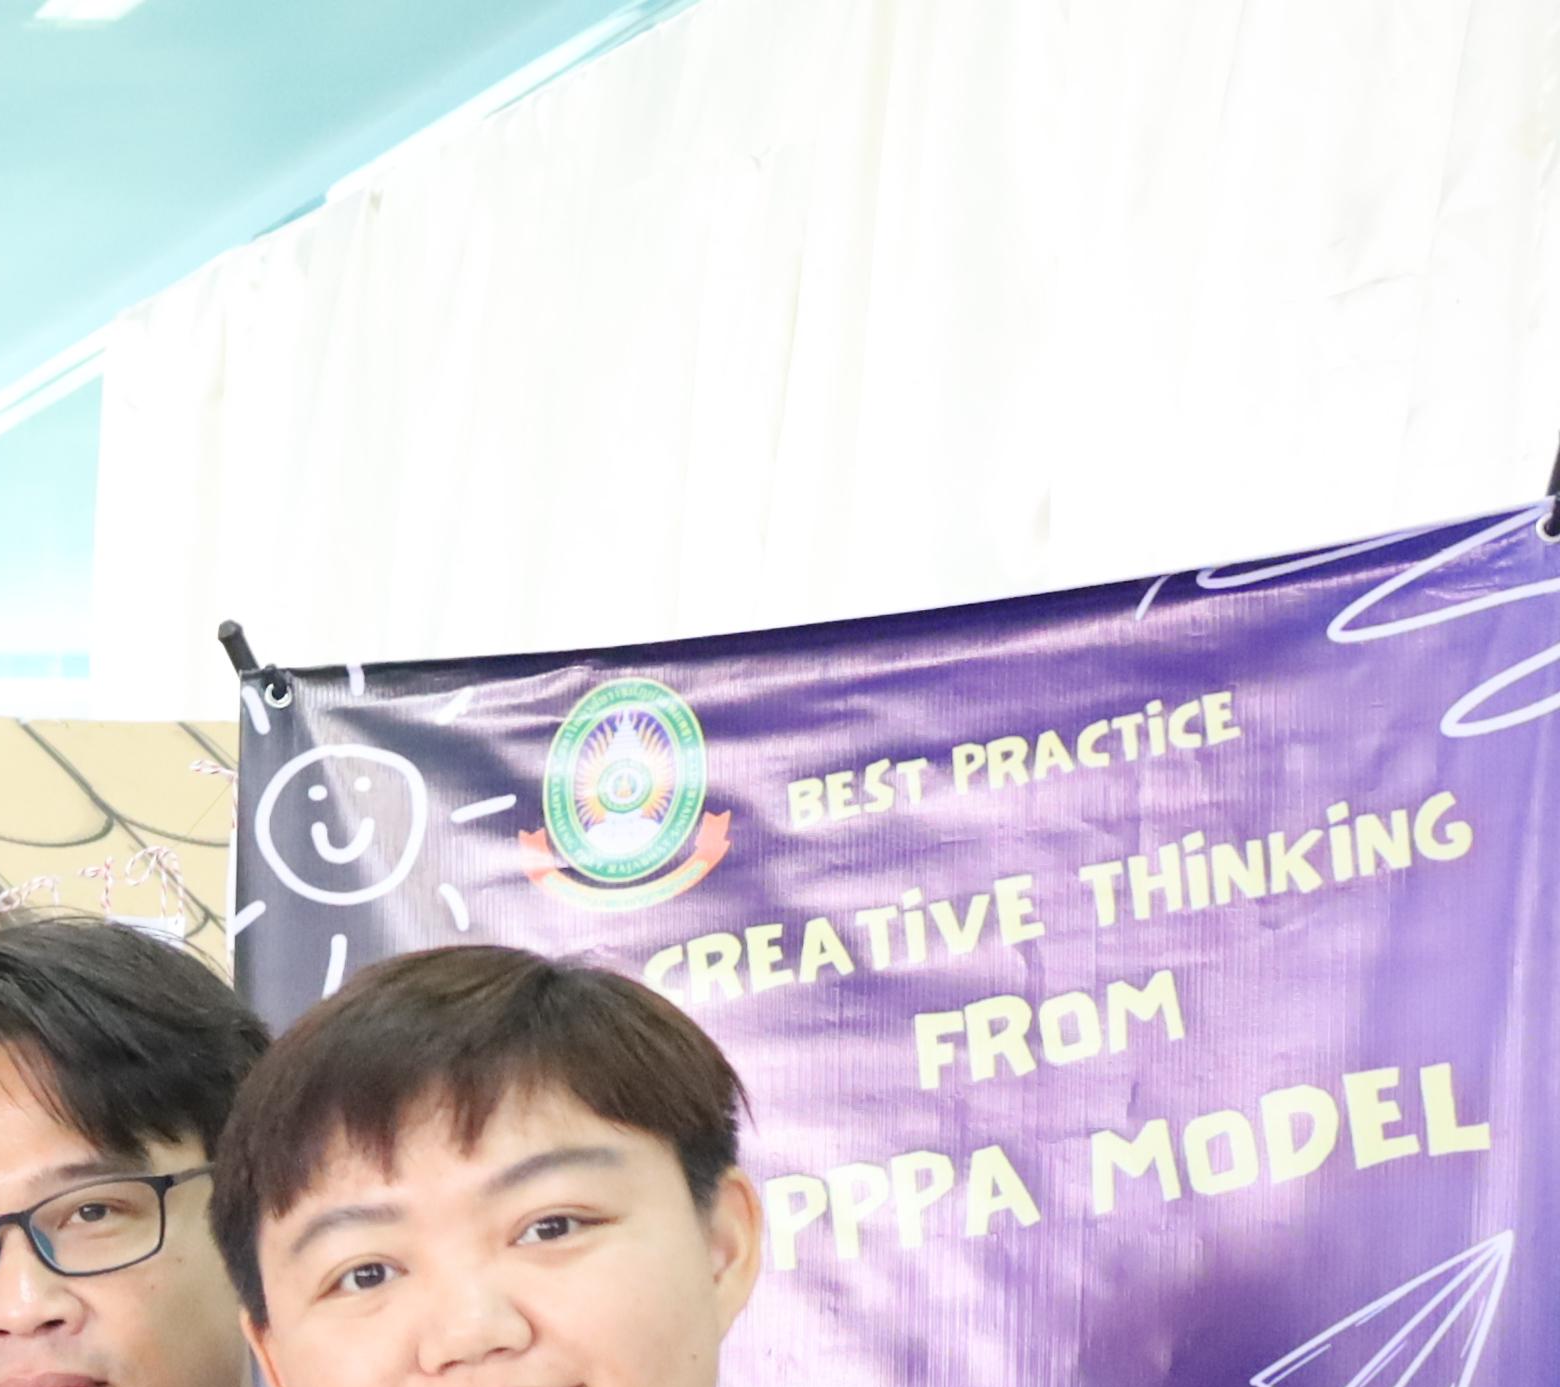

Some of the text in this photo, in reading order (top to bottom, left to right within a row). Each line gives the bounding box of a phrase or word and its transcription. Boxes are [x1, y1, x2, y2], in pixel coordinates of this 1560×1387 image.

[789, 759, 928, 832] BEST
[913, 970, 1185, 1091] FROM
[766, 1062, 1490, 1272] PPPA MODEL
